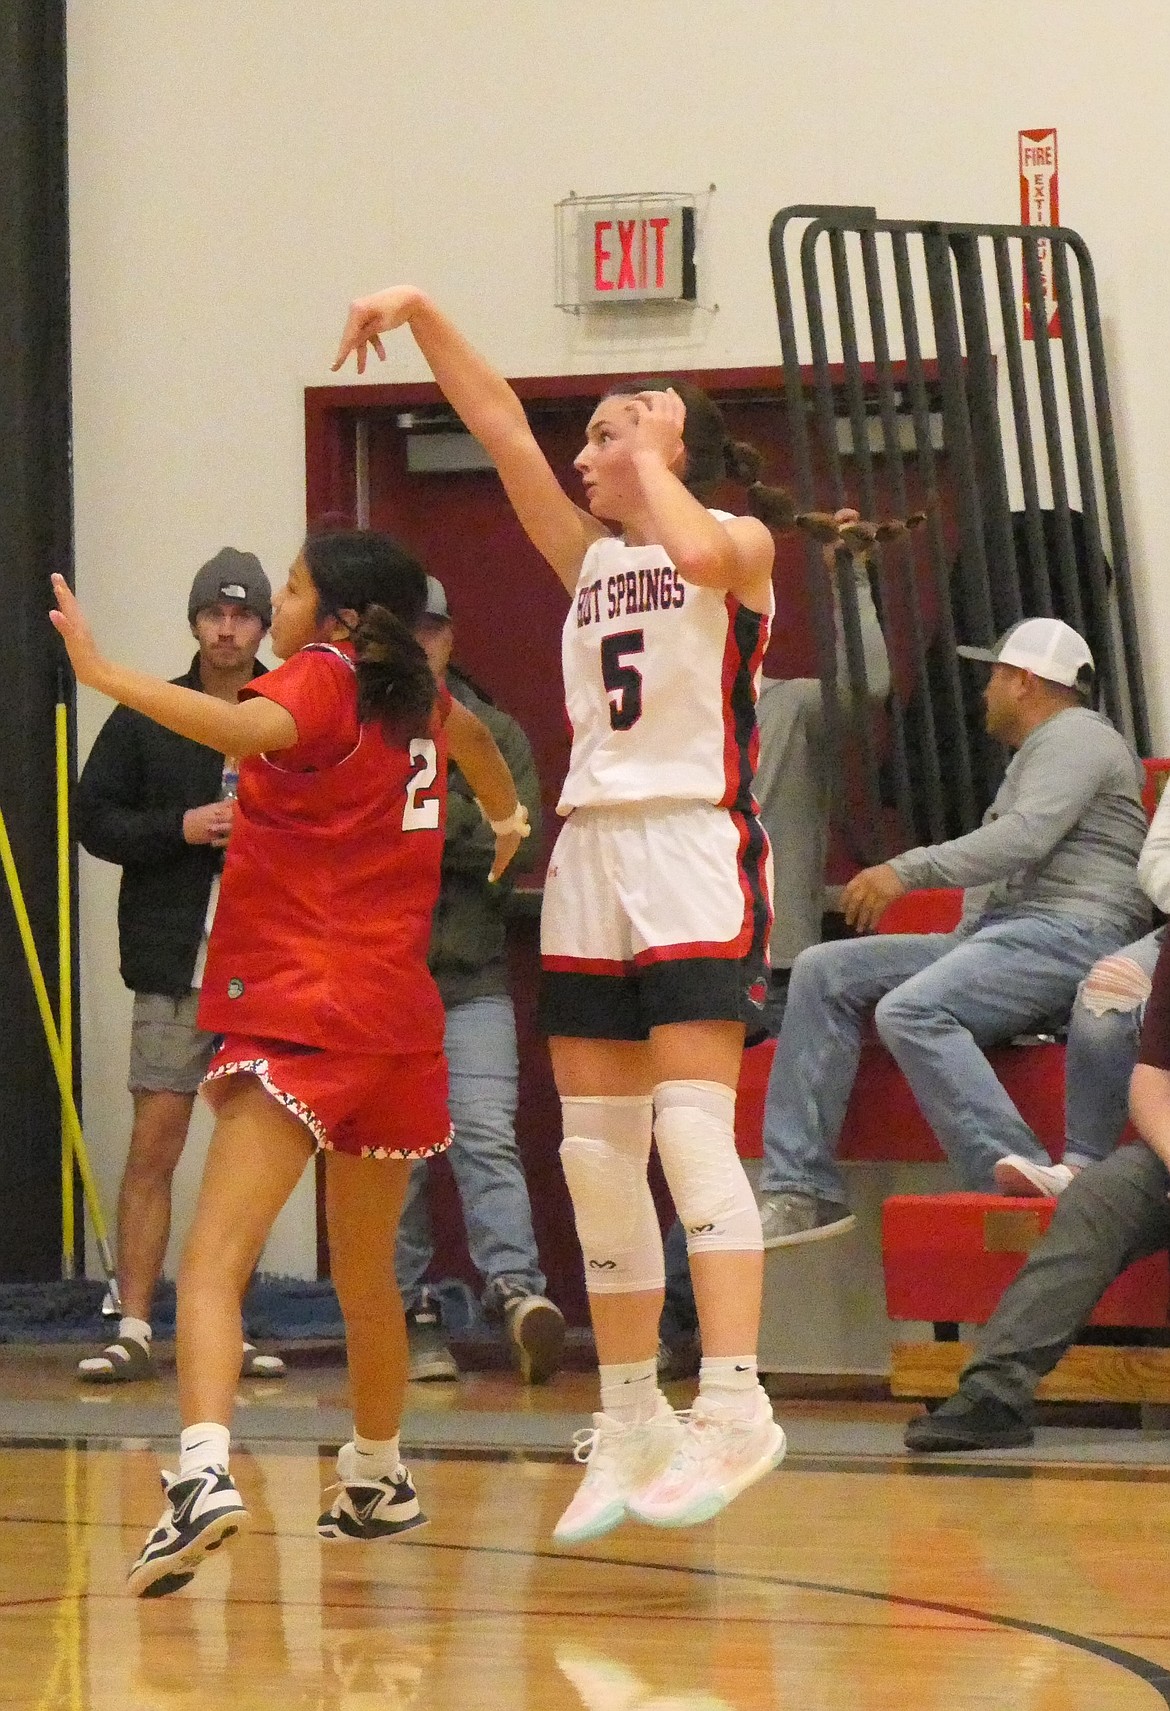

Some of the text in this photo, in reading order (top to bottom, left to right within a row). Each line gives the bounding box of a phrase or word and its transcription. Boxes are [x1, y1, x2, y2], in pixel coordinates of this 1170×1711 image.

[1024, 146, 1053, 167] FIRE
[594, 218, 670, 291] EXIT
[1034, 173, 1047, 298] EXTIGUIS
[577, 566, 685, 628] HOT SPRINGS
[601, 628, 645, 731] 5
[401, 738, 440, 832] 2
